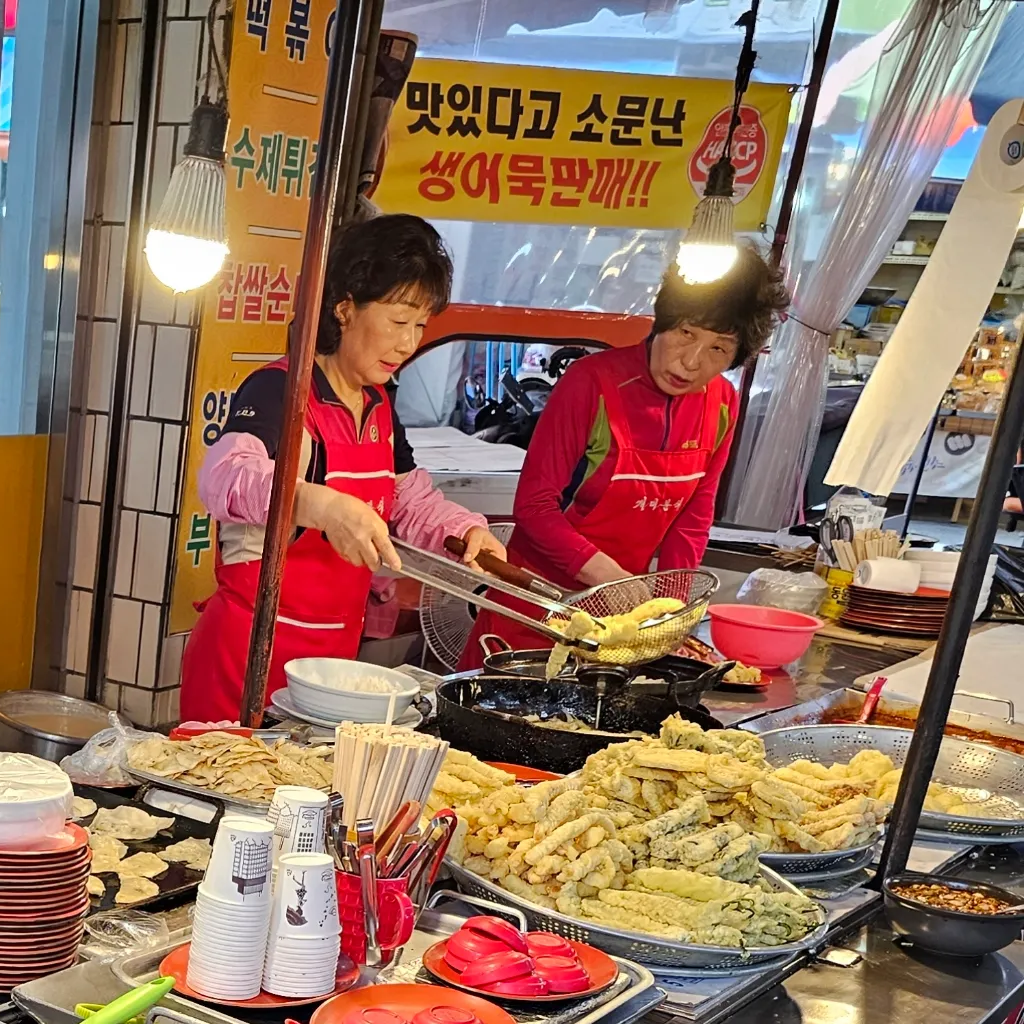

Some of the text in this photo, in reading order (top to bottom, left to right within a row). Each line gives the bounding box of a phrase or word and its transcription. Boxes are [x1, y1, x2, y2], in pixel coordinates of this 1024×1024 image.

[246, 0, 336, 62] 떡볶
[406, 81, 686, 147] 맛있다고 소문난
[418, 150, 662, 210] 생어묵판매!!
[216, 262, 302, 323] 찹쌀순
